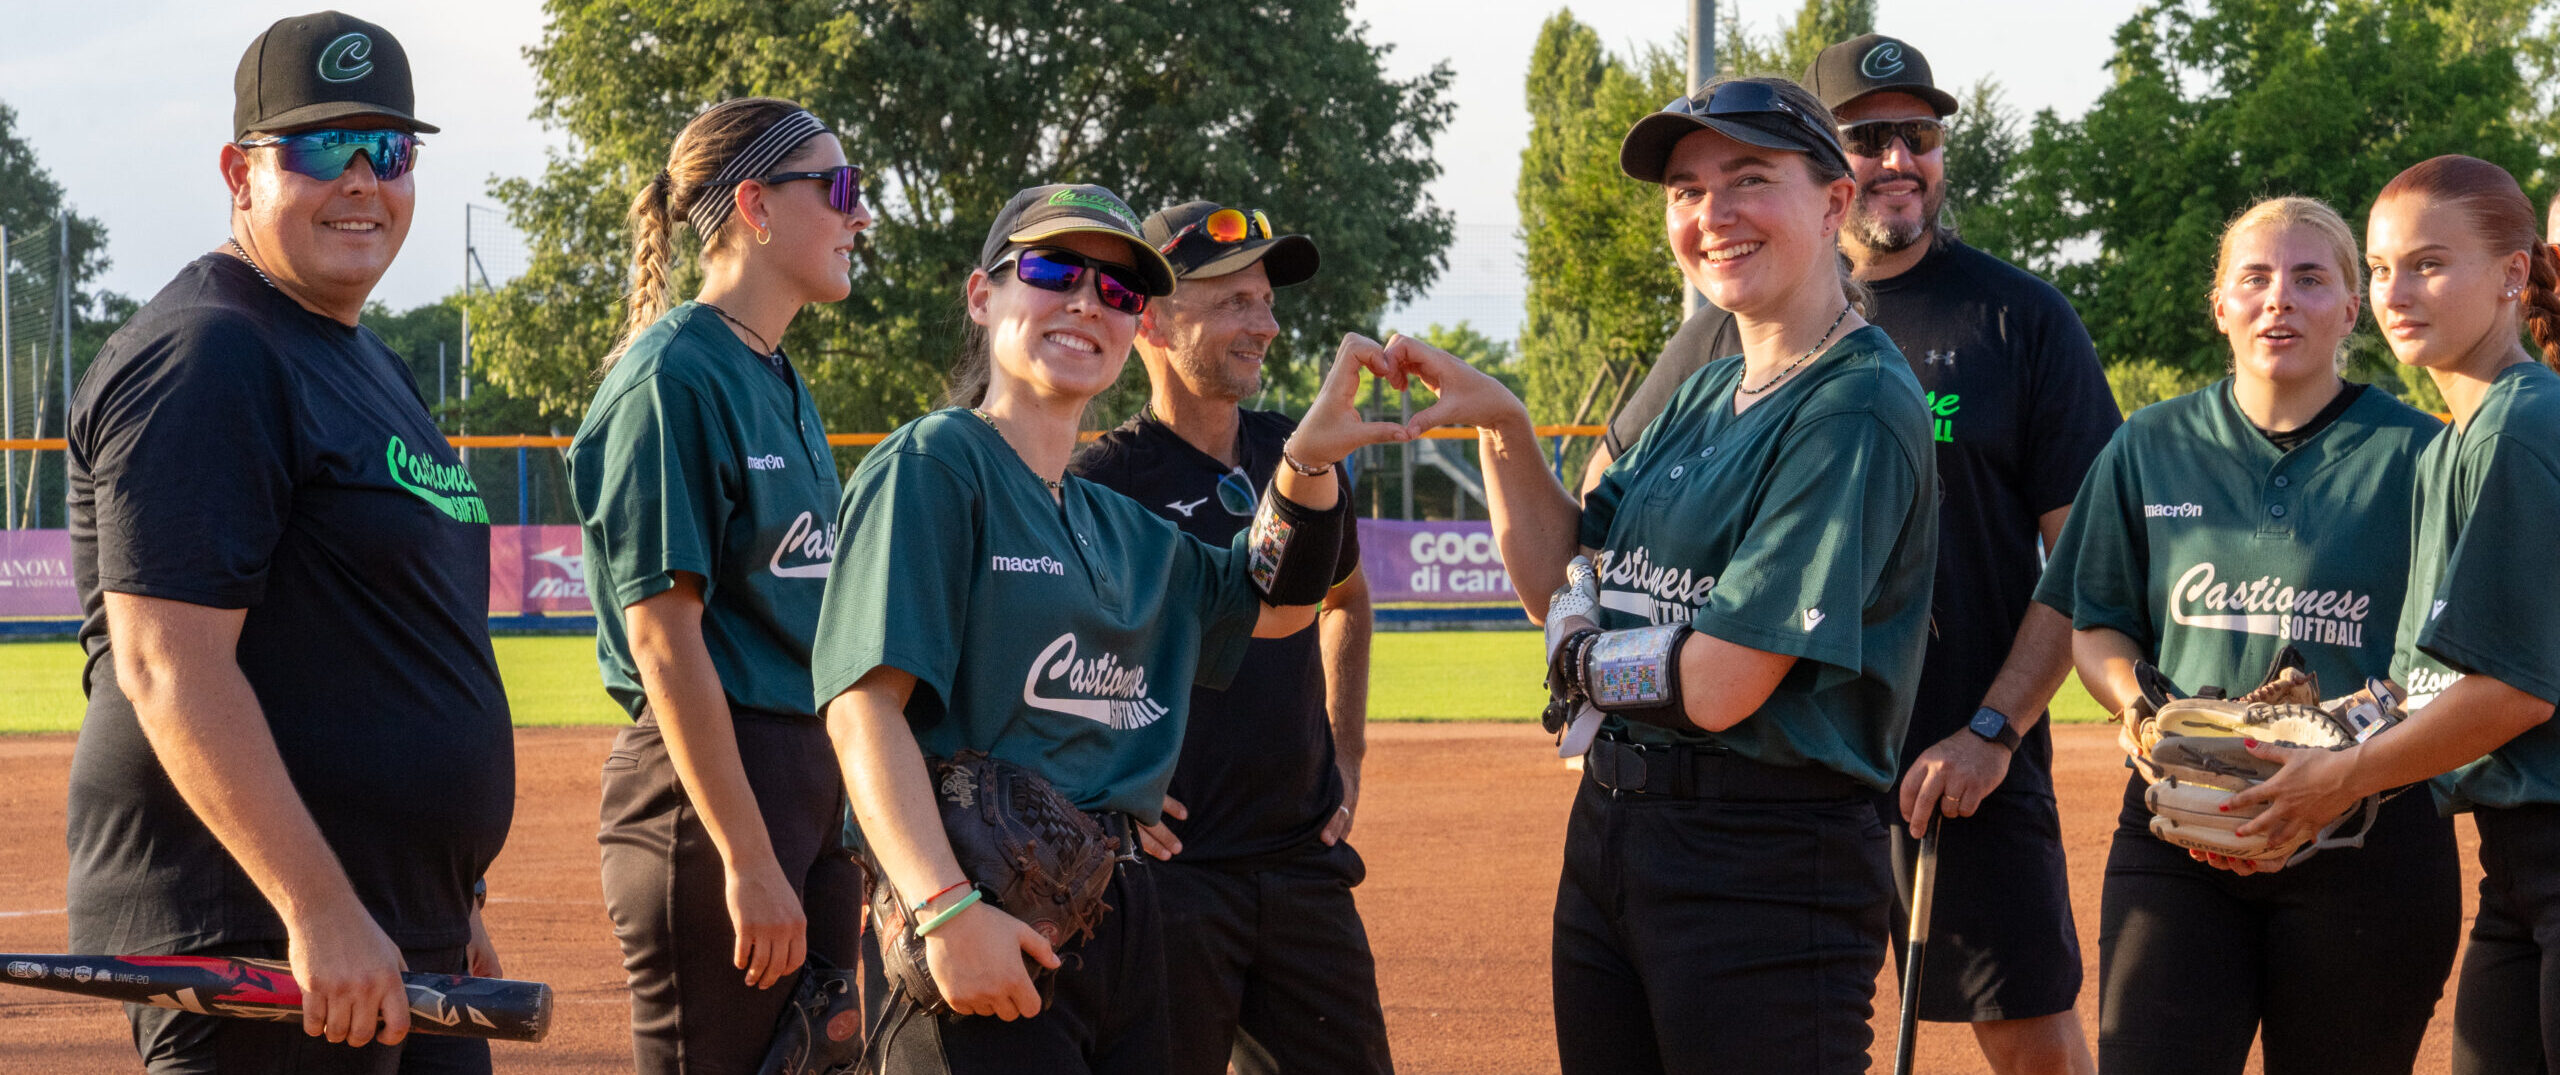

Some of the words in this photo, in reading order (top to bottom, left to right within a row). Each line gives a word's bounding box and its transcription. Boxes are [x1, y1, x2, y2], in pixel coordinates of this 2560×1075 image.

[318, 32, 375, 83] C
[1861, 41, 1905, 79] C
[2144, 502, 2203, 518] macron
[992, 555, 1065, 576] macron
[1410, 565, 1441, 593] di
[526, 577, 590, 599] MIZ
[2170, 561, 2371, 625] Castionese
[2279, 614, 2363, 648] SOFTBALL
